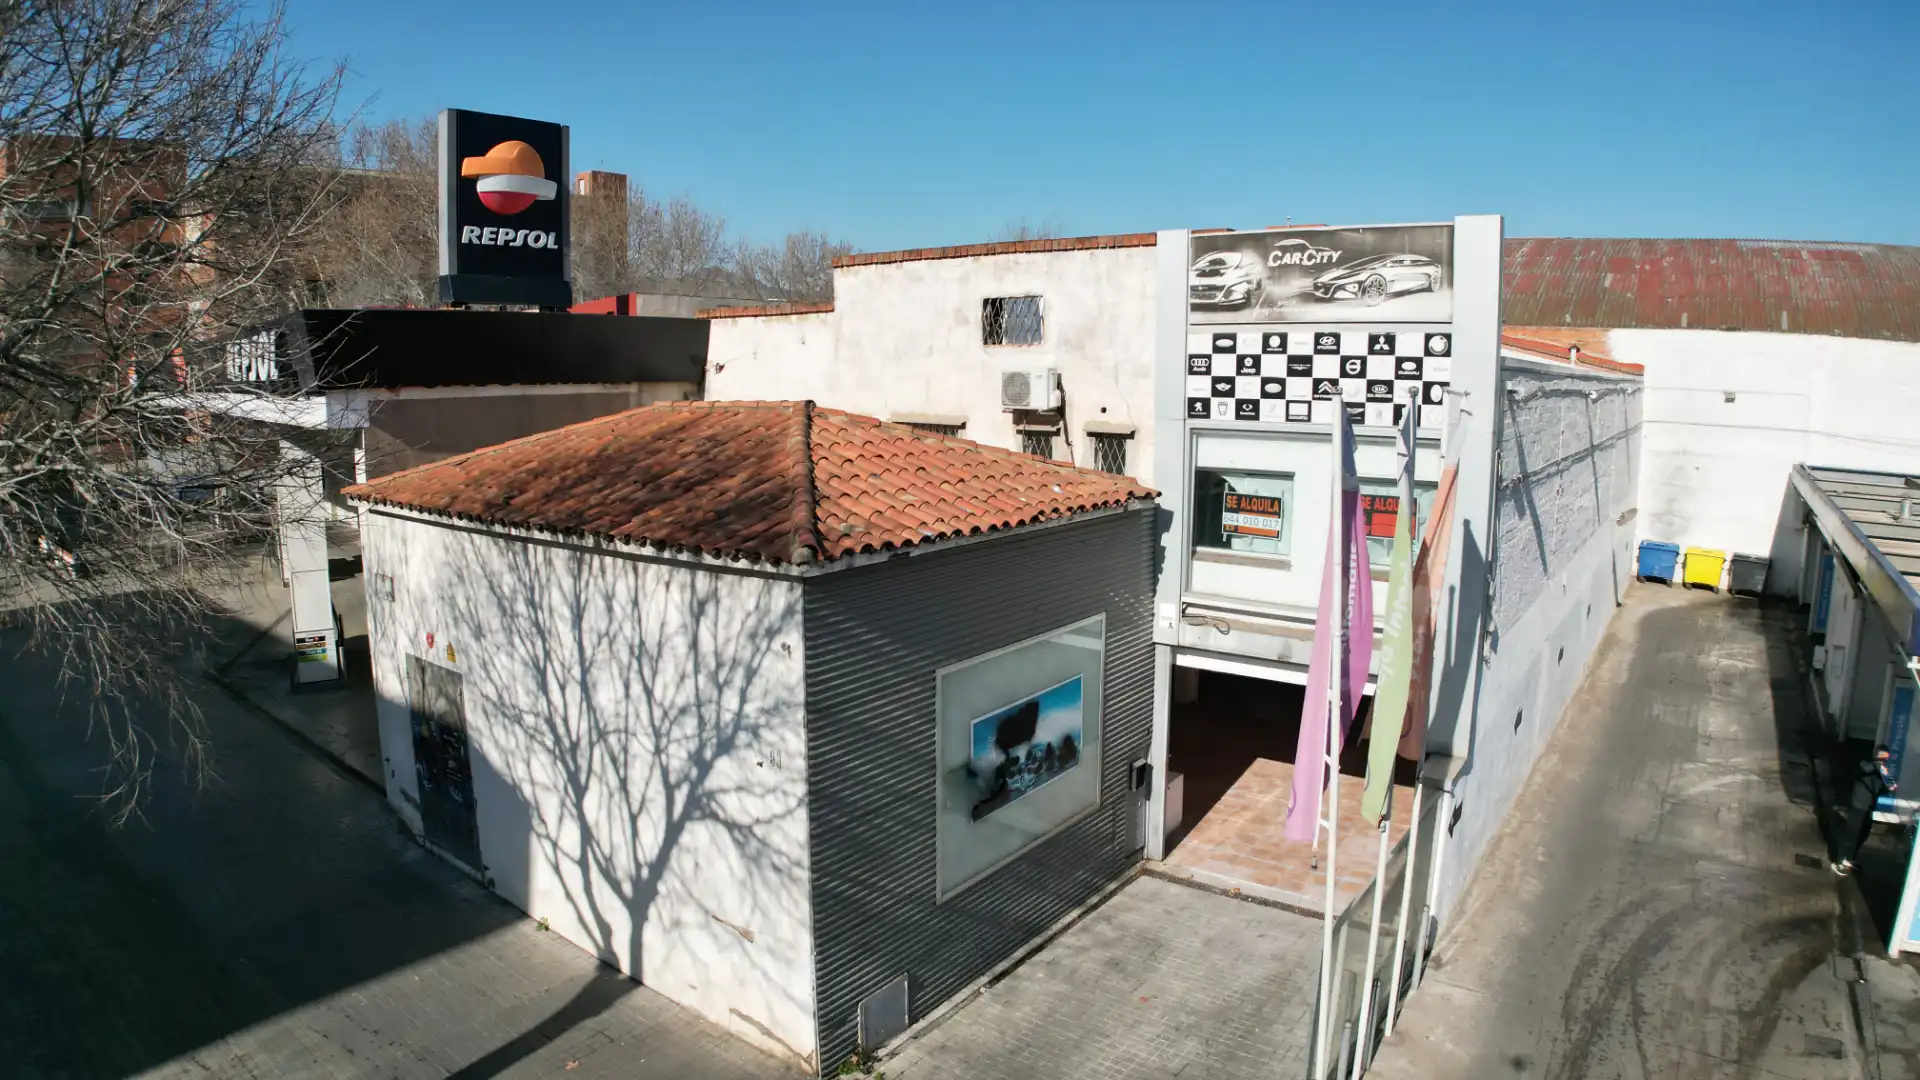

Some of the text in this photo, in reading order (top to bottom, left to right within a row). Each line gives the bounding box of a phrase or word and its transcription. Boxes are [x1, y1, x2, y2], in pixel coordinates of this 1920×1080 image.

[461, 225, 559, 250] REPSOL
[1226, 495, 1279, 512] SE ALQUILA
[1223, 513, 1279, 529] 644 010 017
